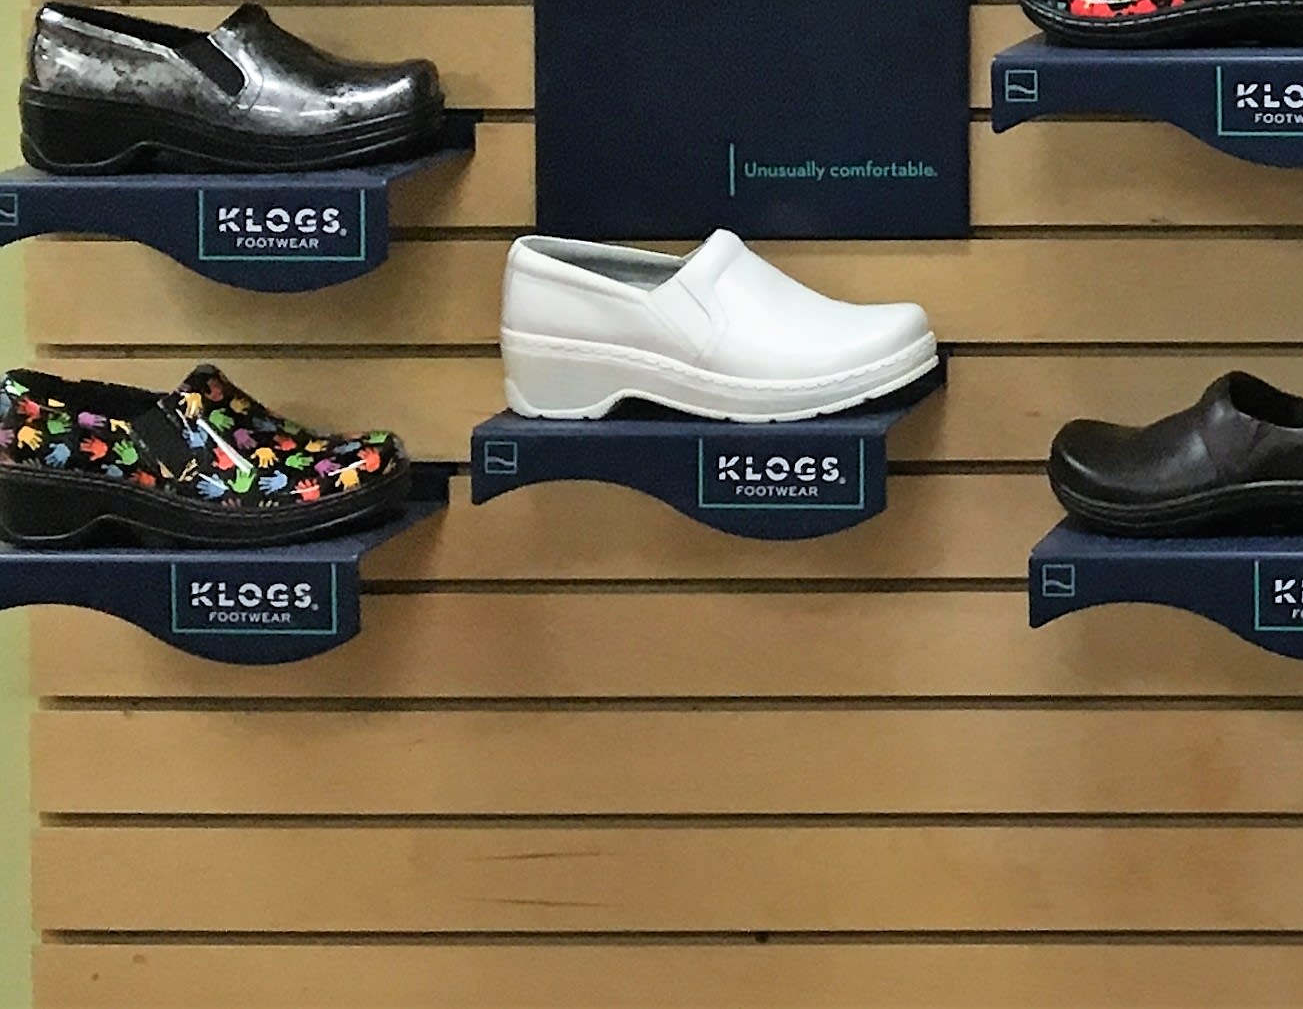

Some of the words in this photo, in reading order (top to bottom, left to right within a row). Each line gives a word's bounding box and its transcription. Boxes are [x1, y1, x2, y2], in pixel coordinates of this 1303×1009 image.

[744, 160, 825, 181] Unusually
[829, 160, 938, 177] comfortable.
[218, 207, 341, 234] KLOGS
[236, 237, 319, 248] FOOTWEAR
[718, 455, 840, 482] KLOGS
[735, 486, 818, 497] FOOTWEAR
[190, 582, 312, 609] KLOGS
[208, 612, 291, 623] FOOTWEAR
